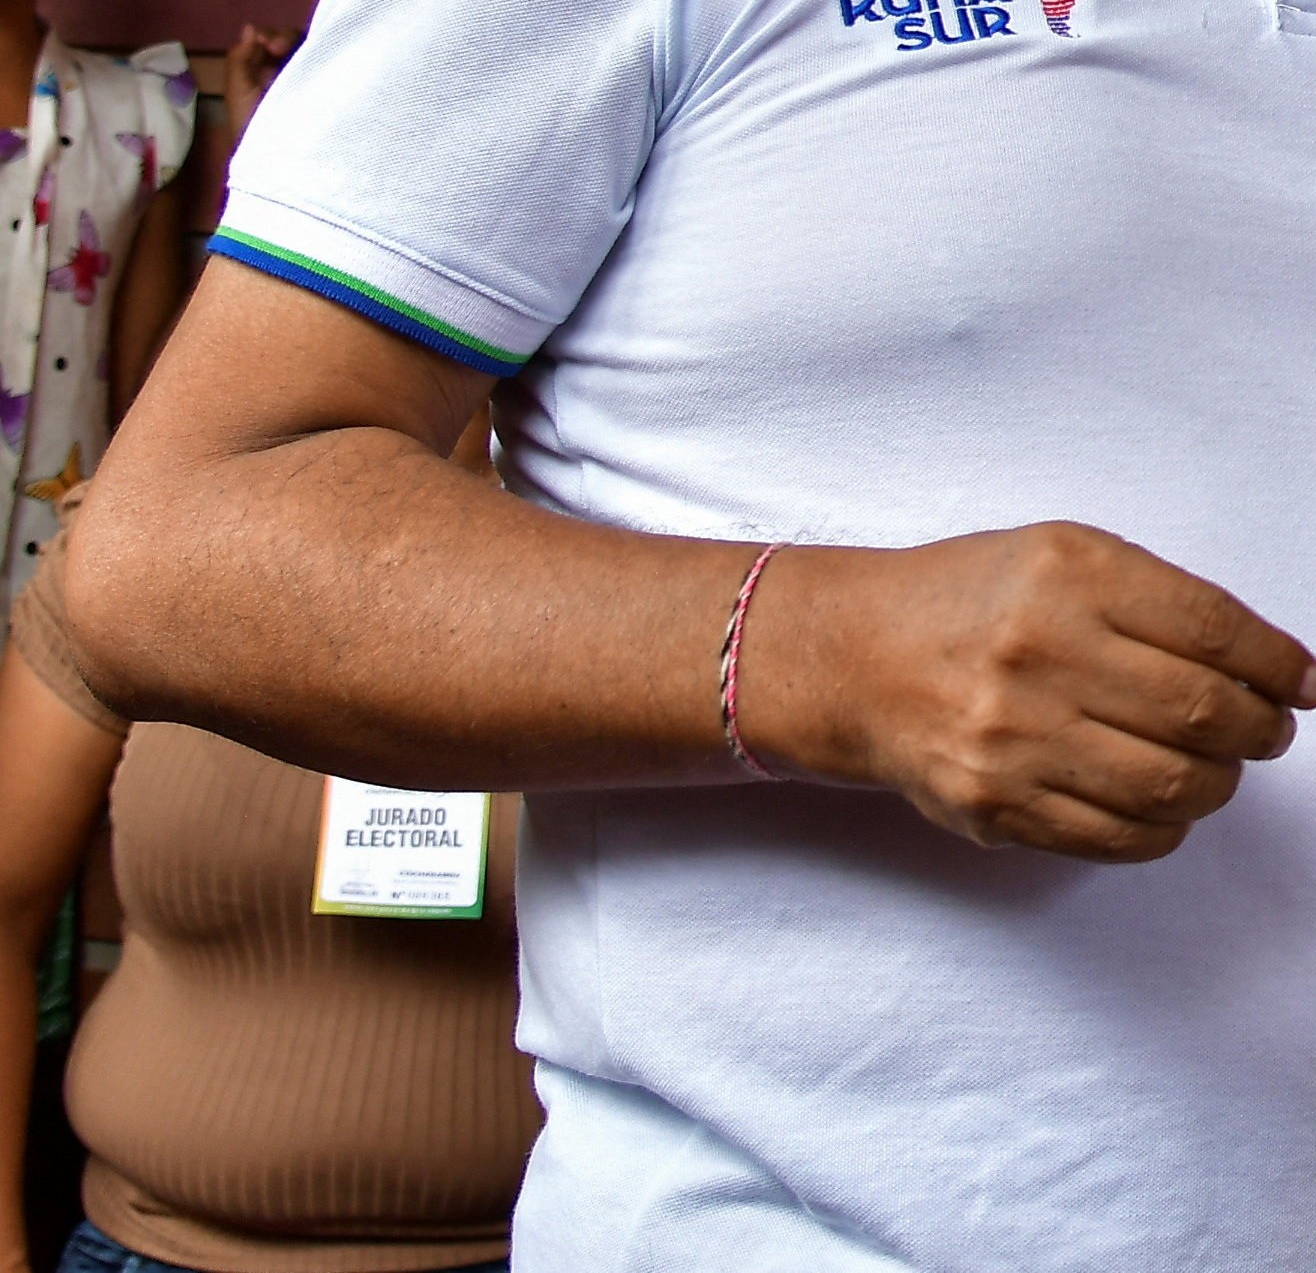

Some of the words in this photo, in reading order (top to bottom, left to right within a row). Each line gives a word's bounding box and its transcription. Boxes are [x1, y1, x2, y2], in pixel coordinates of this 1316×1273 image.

[894, 6, 1018, 51] SUR
[365, 808, 447, 827] JURADO
[345, 829, 463, 848] ELECTORAL
